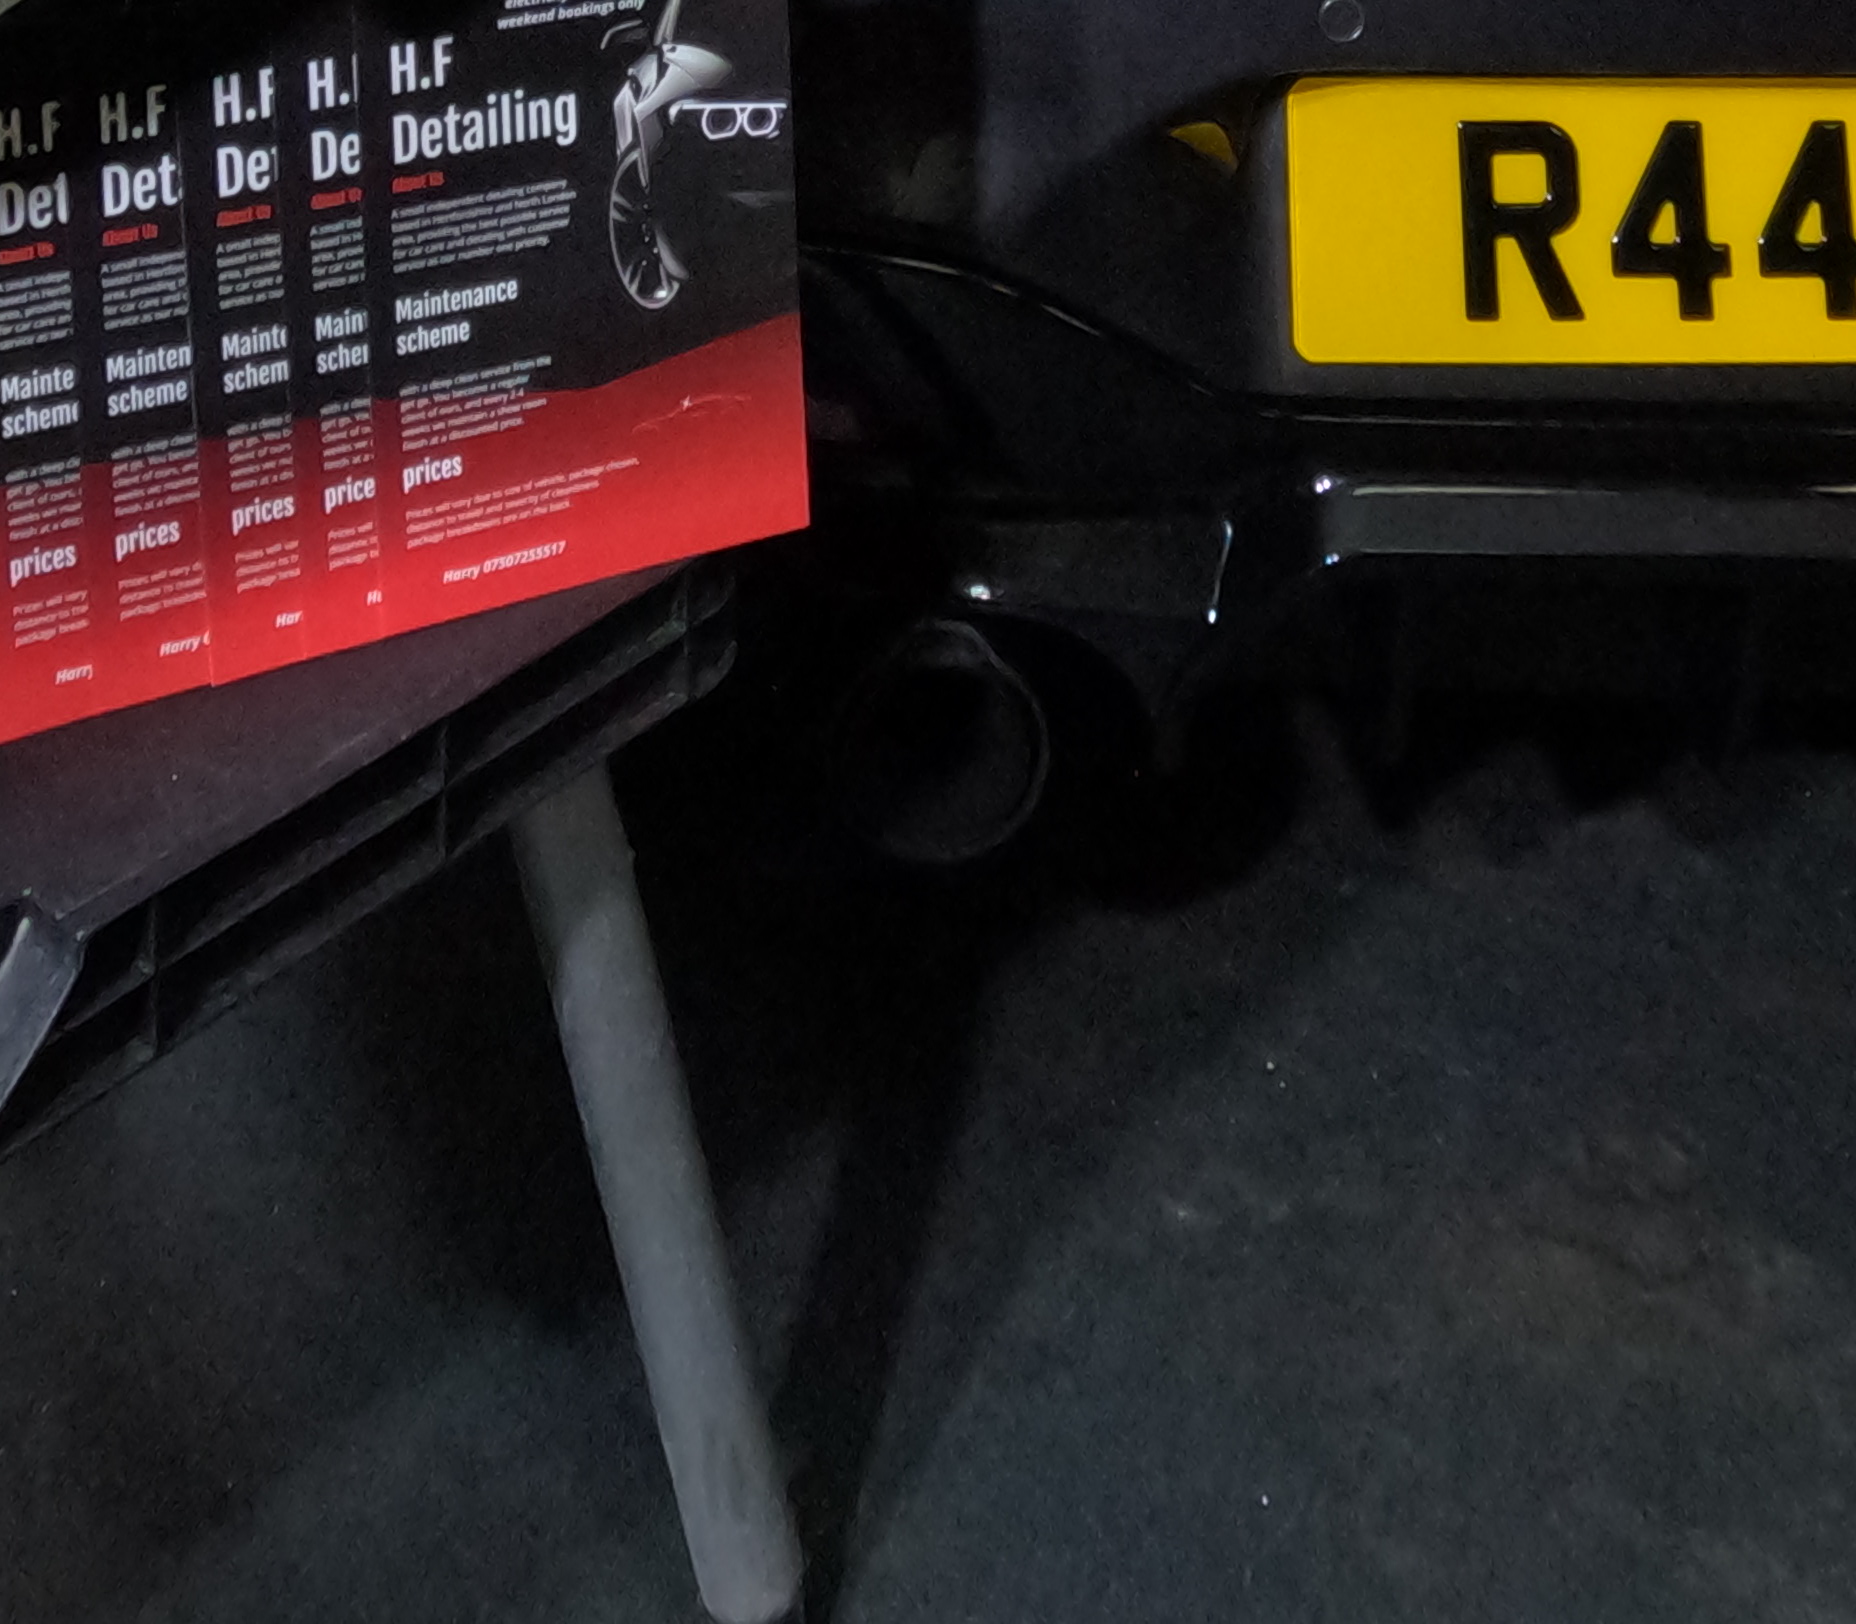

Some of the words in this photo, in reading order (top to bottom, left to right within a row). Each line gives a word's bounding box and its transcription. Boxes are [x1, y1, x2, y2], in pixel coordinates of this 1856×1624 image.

[496, 8, 555, 31] weekend
[307, 52, 359, 112] H.
[390, 34, 454, 96] H.F
[98, 83, 168, 145] H.F
[393, 88, 578, 166] Detailing
[101, 153, 183, 219] Det
[395, 279, 519, 324] Maintenance
[396, 320, 471, 357] scheme
[105, 345, 193, 384] Mainten
[0, 367, 76, 405] Mainte
[107, 379, 189, 419] scheme
[324, 475, 377, 515] price
[402, 455, 464, 495] prices
[231, 496, 295, 537] prices
[114, 520, 181, 564] prices
[9, 543, 77, 589] prices
[443, 562, 482, 585] Harry
[158, 634, 201, 658] Harry
